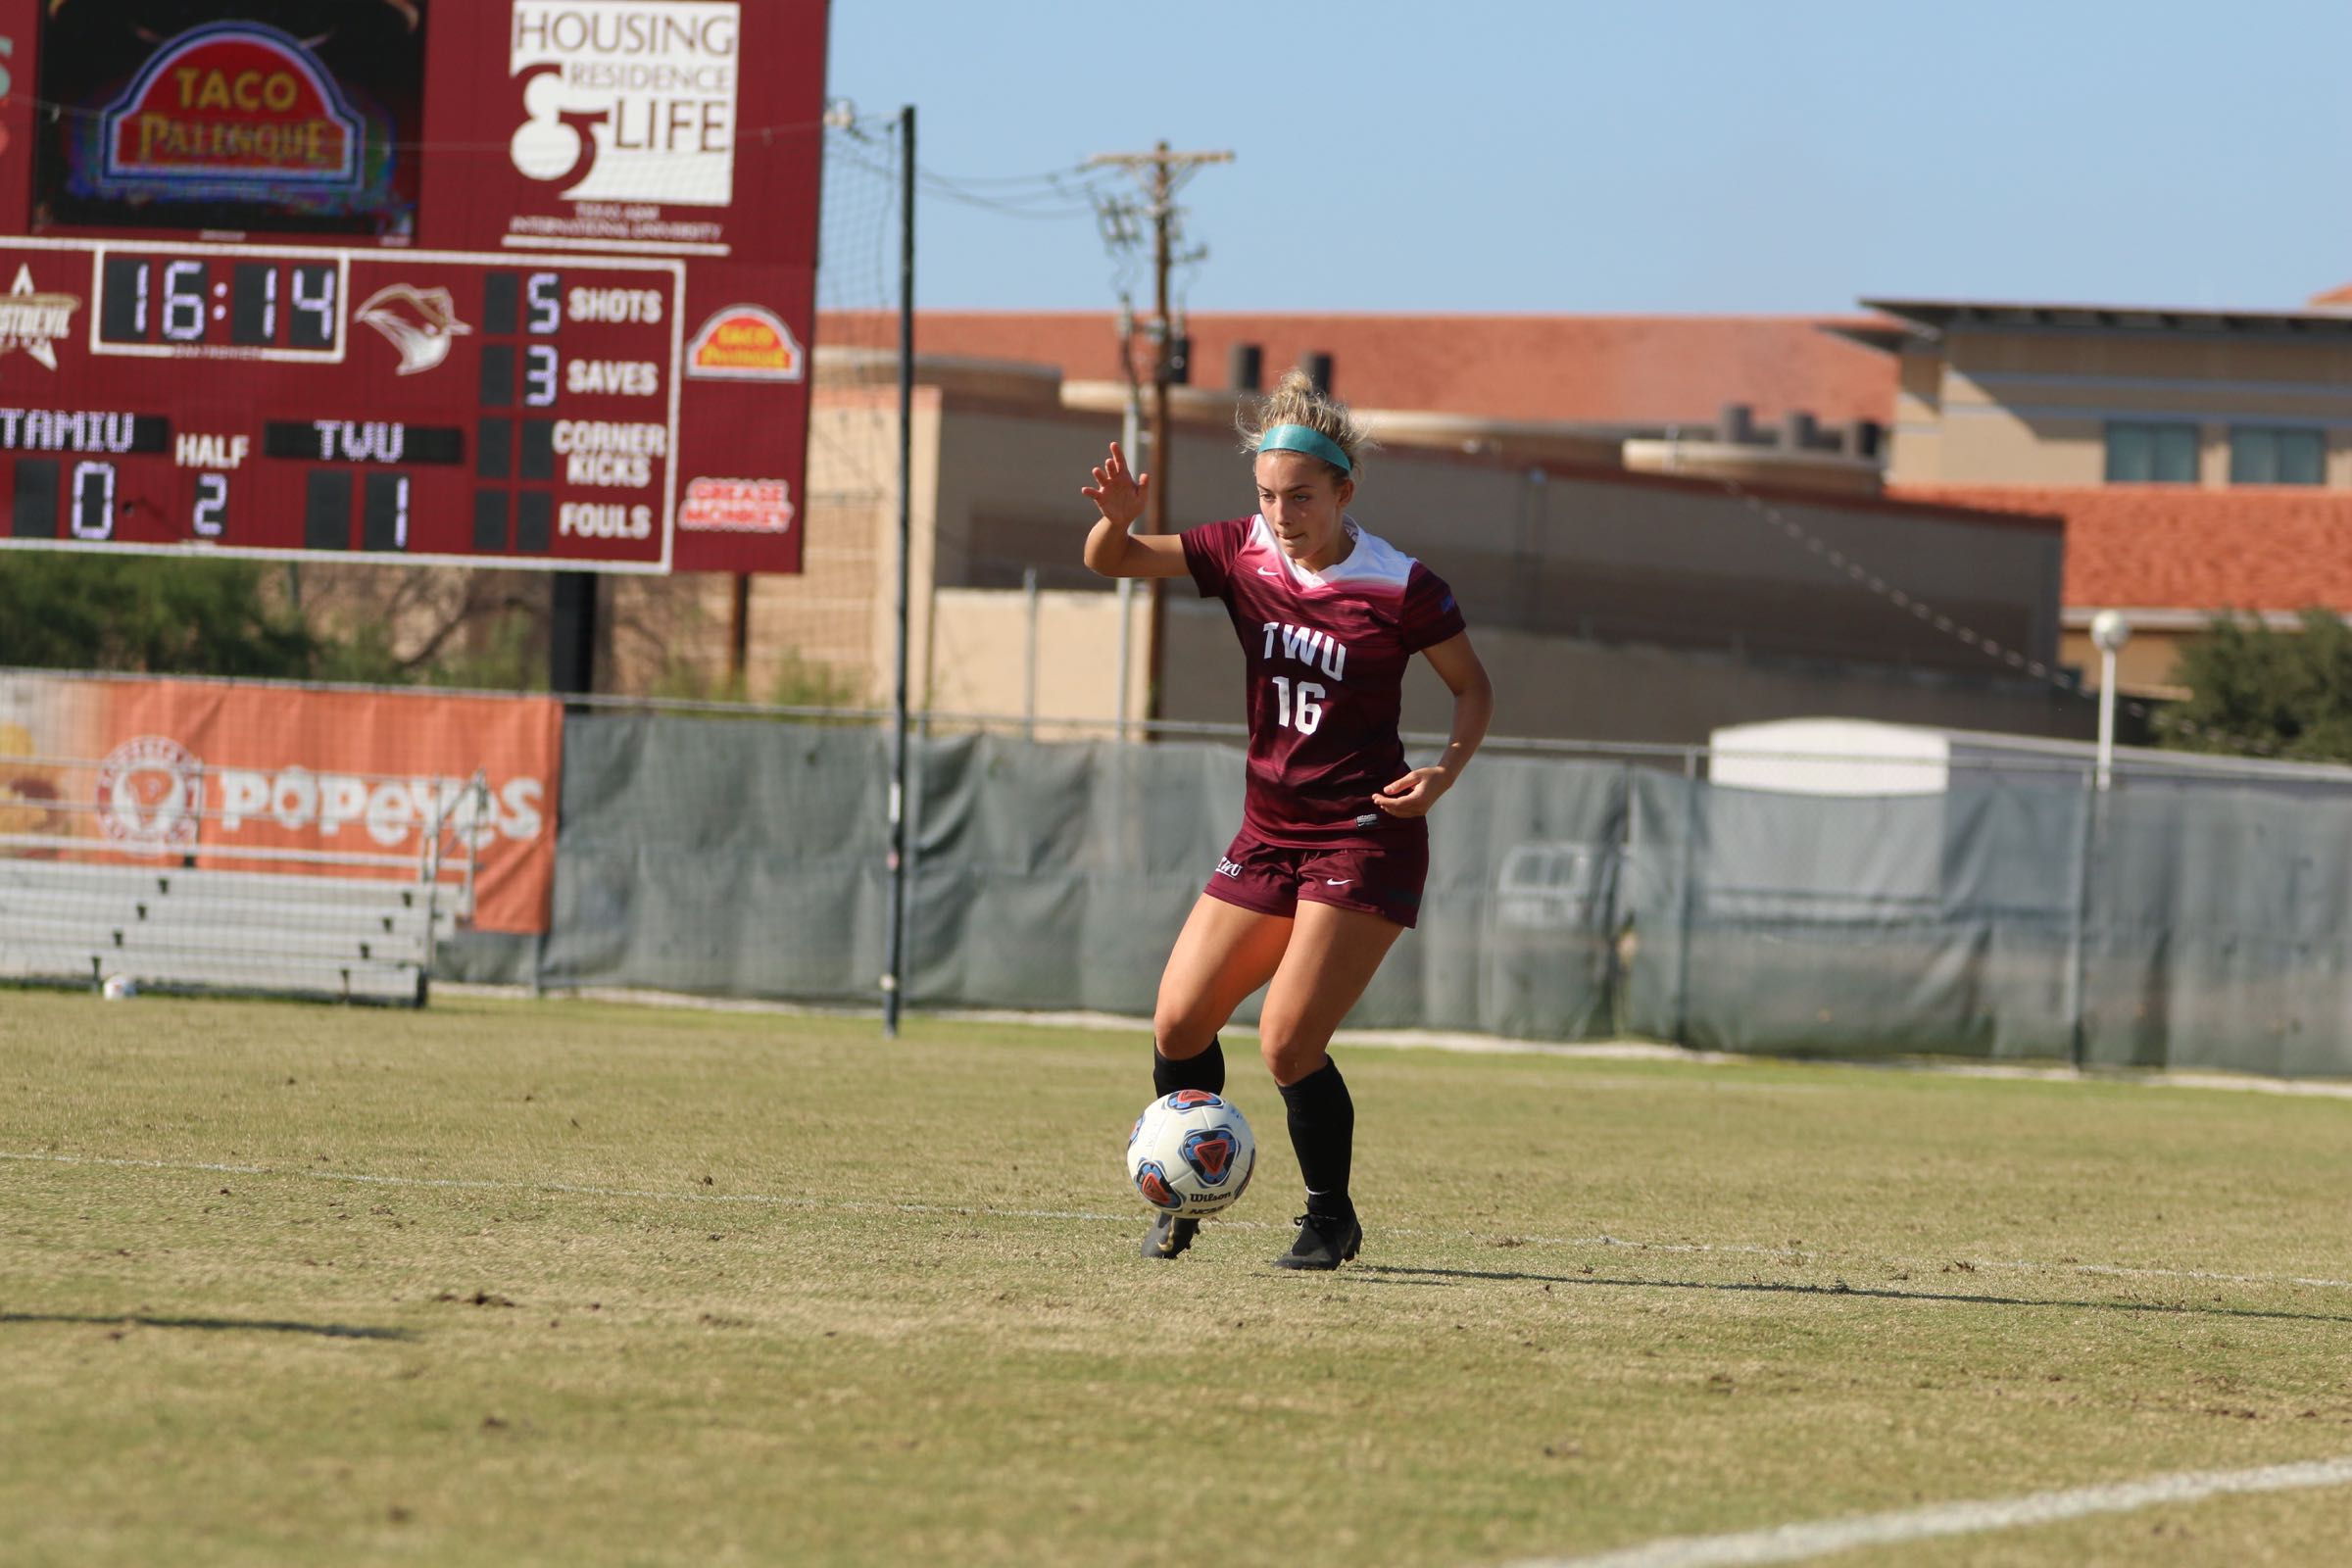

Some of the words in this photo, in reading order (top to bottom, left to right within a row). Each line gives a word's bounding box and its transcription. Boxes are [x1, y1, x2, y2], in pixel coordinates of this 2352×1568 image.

[515, 11, 733, 56] HOUSING
[174, 67, 297, 112] TACO
[568, 63, 731, 92] RESIDENCE
[615, 98, 727, 153] LIFE
[133, 259, 336, 341] 16:14
[526, 272, 561, 334] 5
[567, 287, 663, 324] SHOTS
[525, 345, 559, 407] 3
[566, 360, 659, 396] SAVES
[0, 408, 134, 453] TAMIU
[175, 433, 250, 468] HALF
[314, 419, 405, 464] TWU
[553, 419, 667, 458] CORNER
[566, 453, 652, 488] KICKS
[72, 461, 116, 541] 0
[193, 473, 227, 536] 2
[394, 476, 410, 549] 1
[559, 503, 653, 539] FOULS
[1262, 621, 1348, 682] TWU
[1272, 676, 1326, 736] 16
[1217, 856, 1244, 877] TWU
[1190, 1192, 1232, 1202] Wilson
